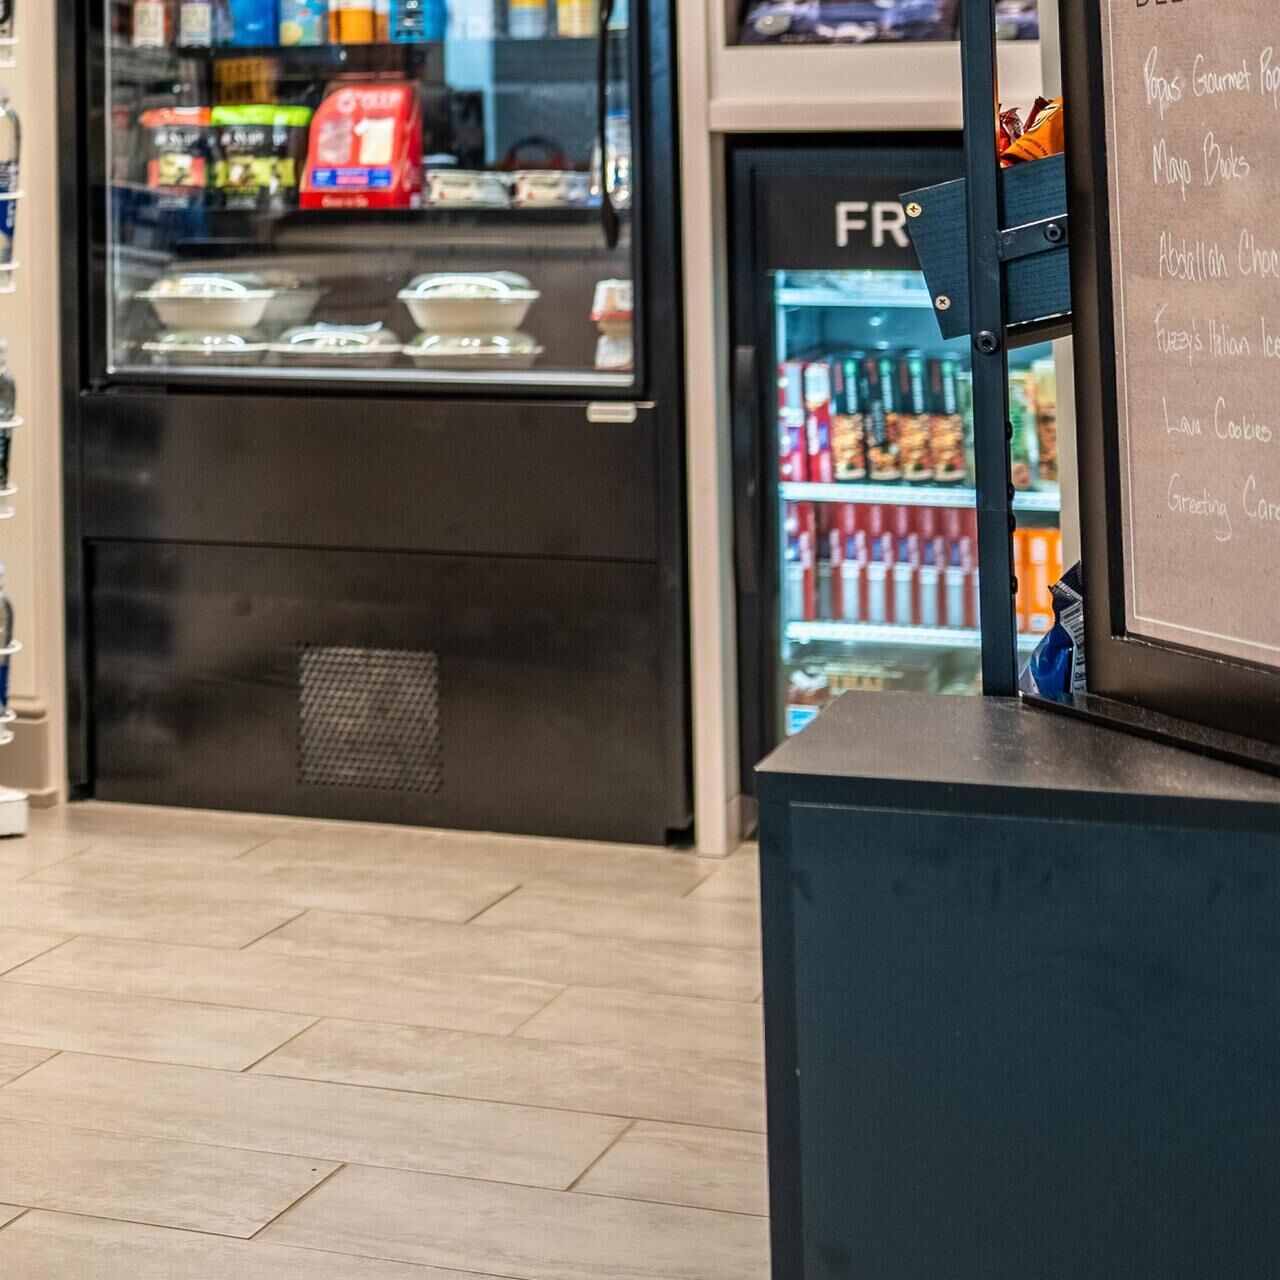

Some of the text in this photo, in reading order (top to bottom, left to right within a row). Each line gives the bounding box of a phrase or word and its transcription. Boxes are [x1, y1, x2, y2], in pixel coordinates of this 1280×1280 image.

[1192, 54, 1252, 97] Gourmet
[1152, 131, 1251, 202] Mayo Books
[1159, 230, 1229, 282] Abdallah
[1154, 303, 1203, 368] Fuzzy's
[1209, 319, 1251, 358] Italian
[1162, 396, 1273, 443] Lava Cookies
[1167, 473, 1233, 542] Greeting
